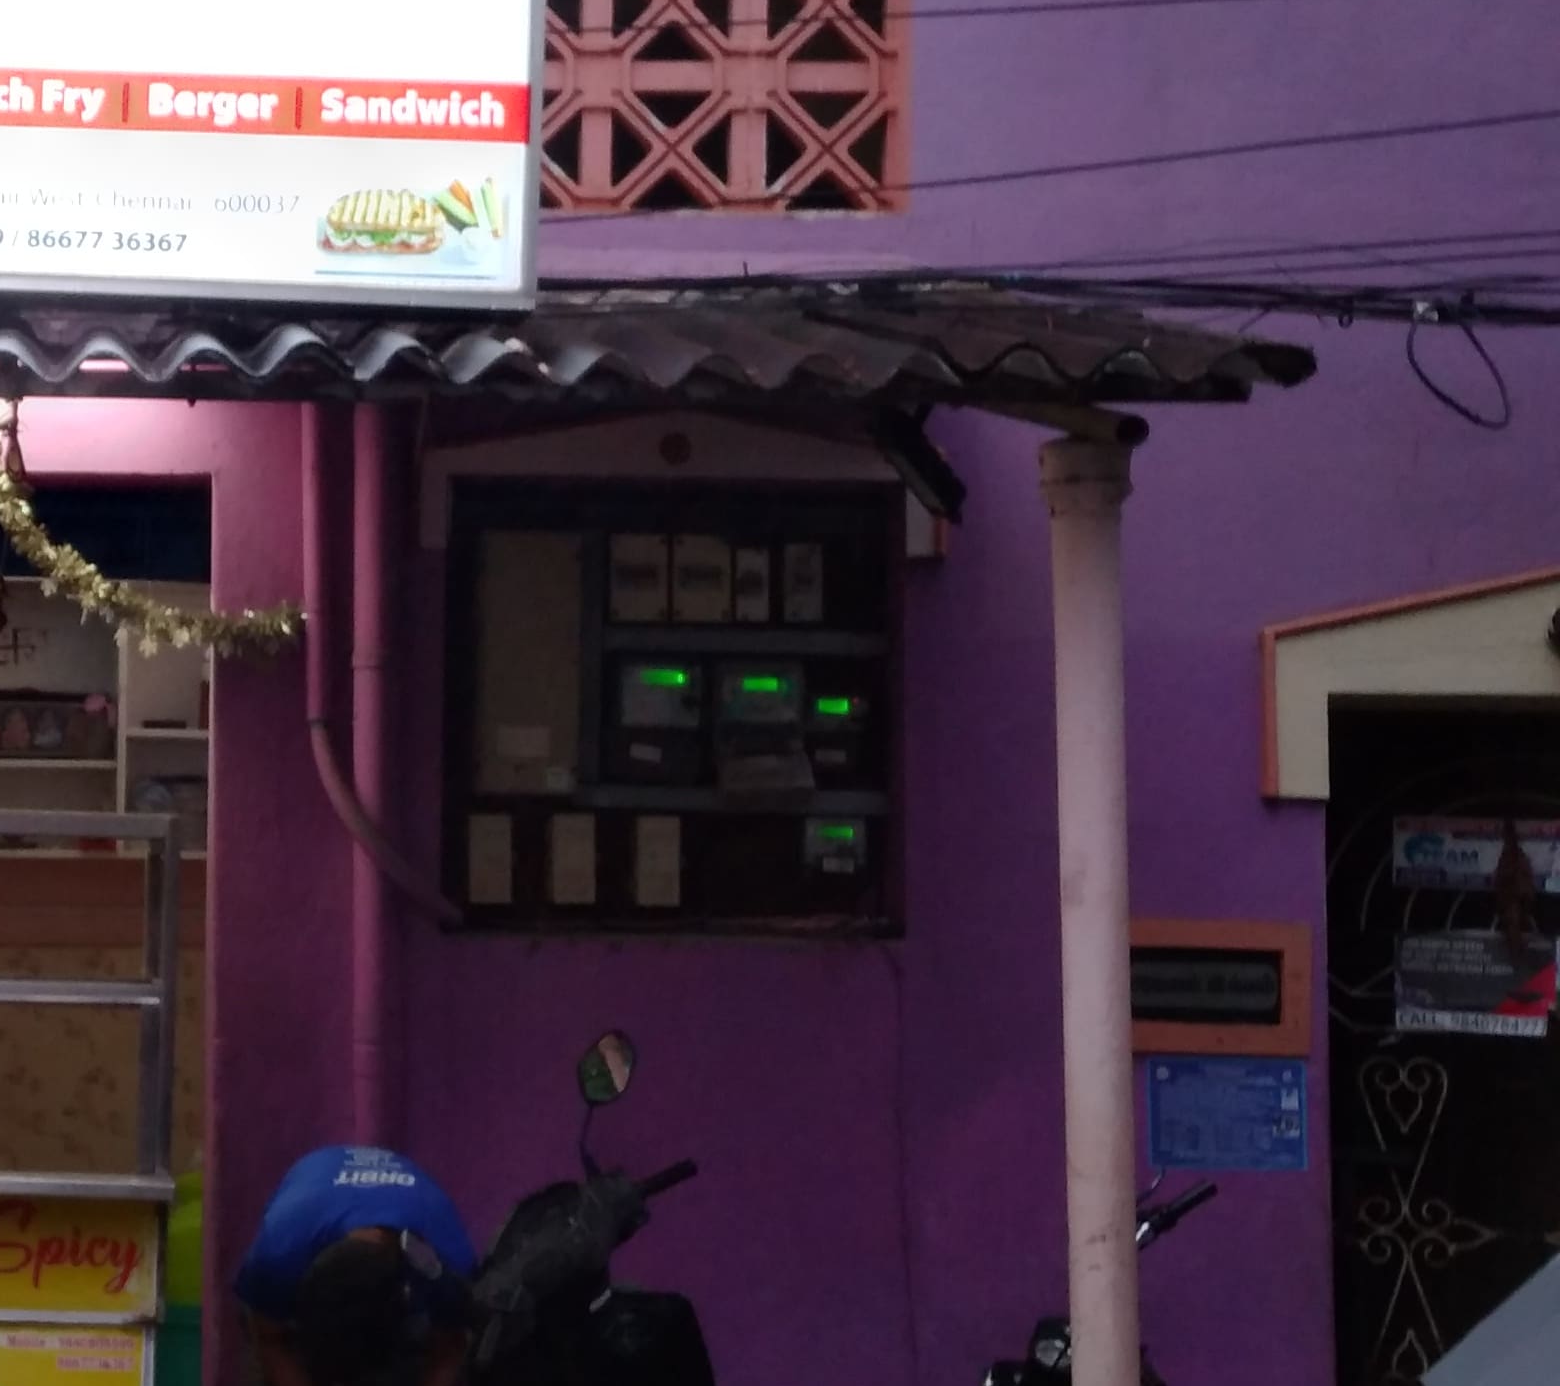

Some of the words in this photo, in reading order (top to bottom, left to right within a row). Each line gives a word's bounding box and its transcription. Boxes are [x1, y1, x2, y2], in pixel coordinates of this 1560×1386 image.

[41, 78, 106, 122] Fry
[148, 82, 278, 125] Berger
[321, 88, 506, 127] Sandwich
[30, 187, 83, 207] Wet
[26, 228, 104, 249] 86677
[111, 231, 188, 252] 36367
